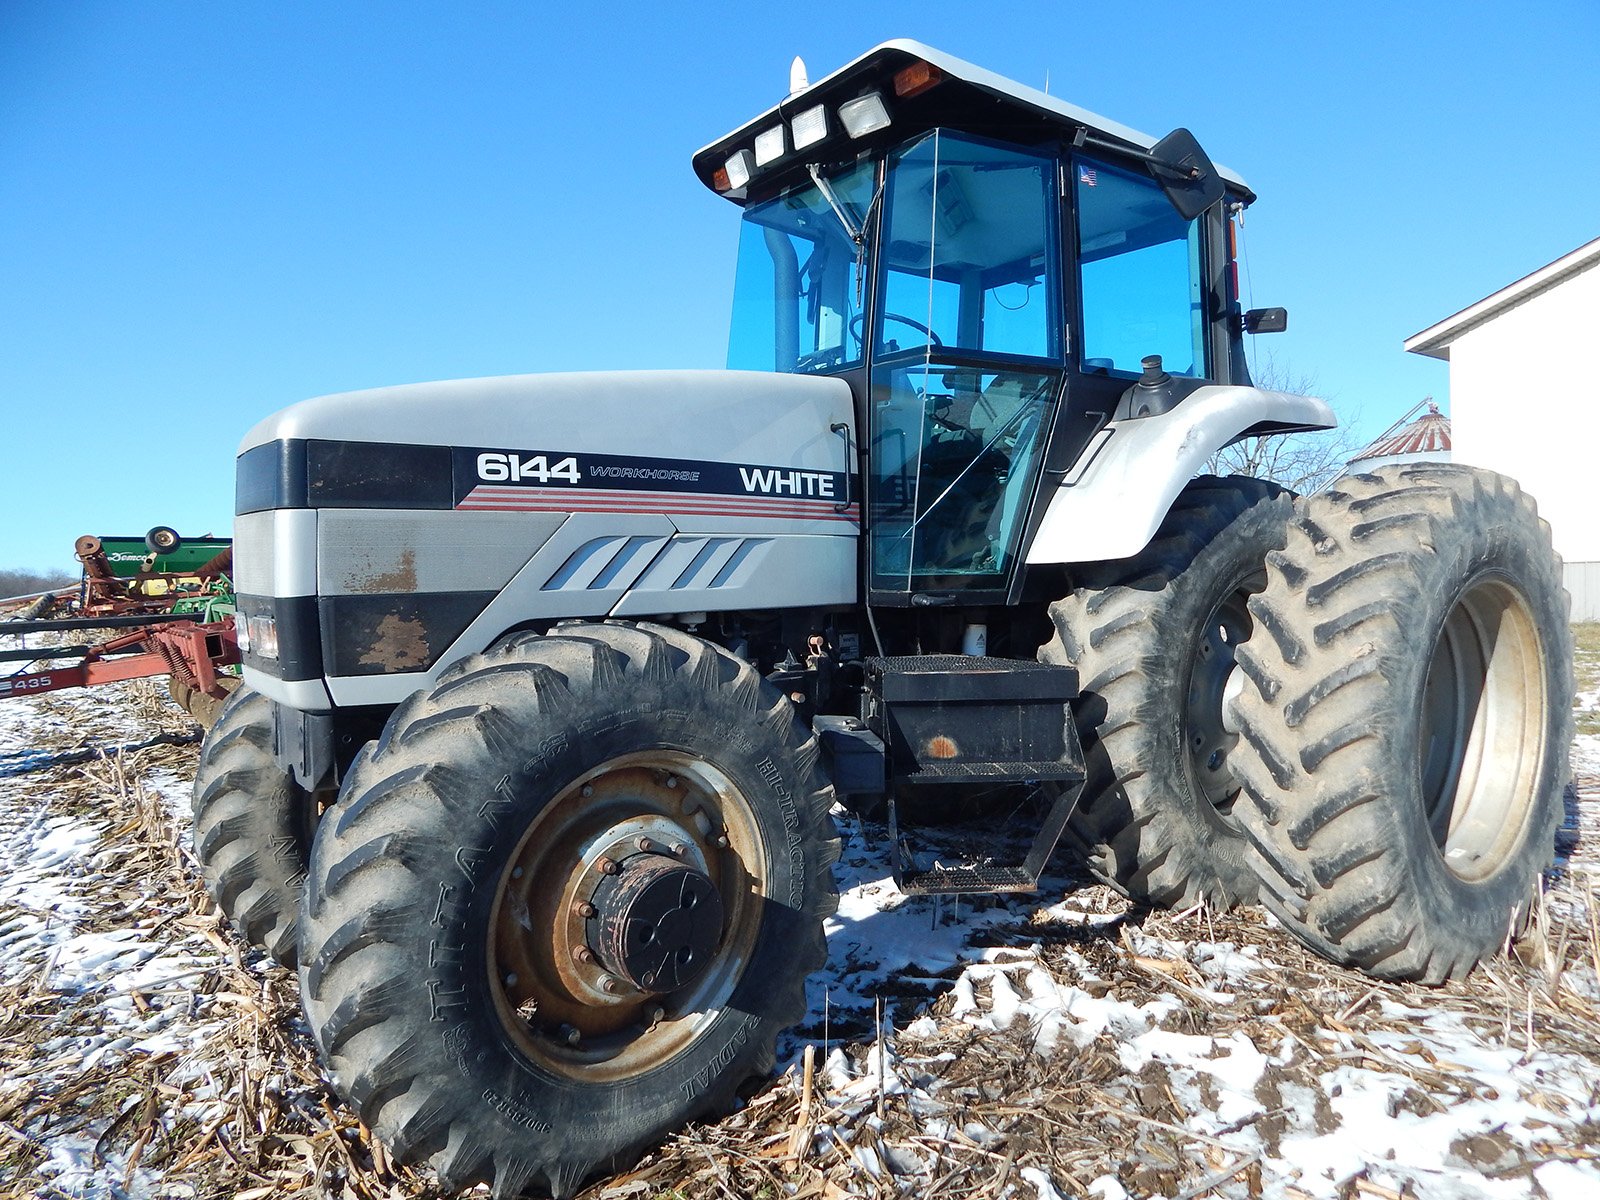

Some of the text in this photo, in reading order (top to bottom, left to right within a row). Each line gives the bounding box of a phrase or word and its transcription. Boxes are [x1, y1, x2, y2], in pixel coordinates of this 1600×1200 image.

[476, 452, 582, 484] 6144
[590, 465, 701, 482] WORKHORSE
[738, 466, 835, 497] WHITE
[14, 676, 52, 690] 435
